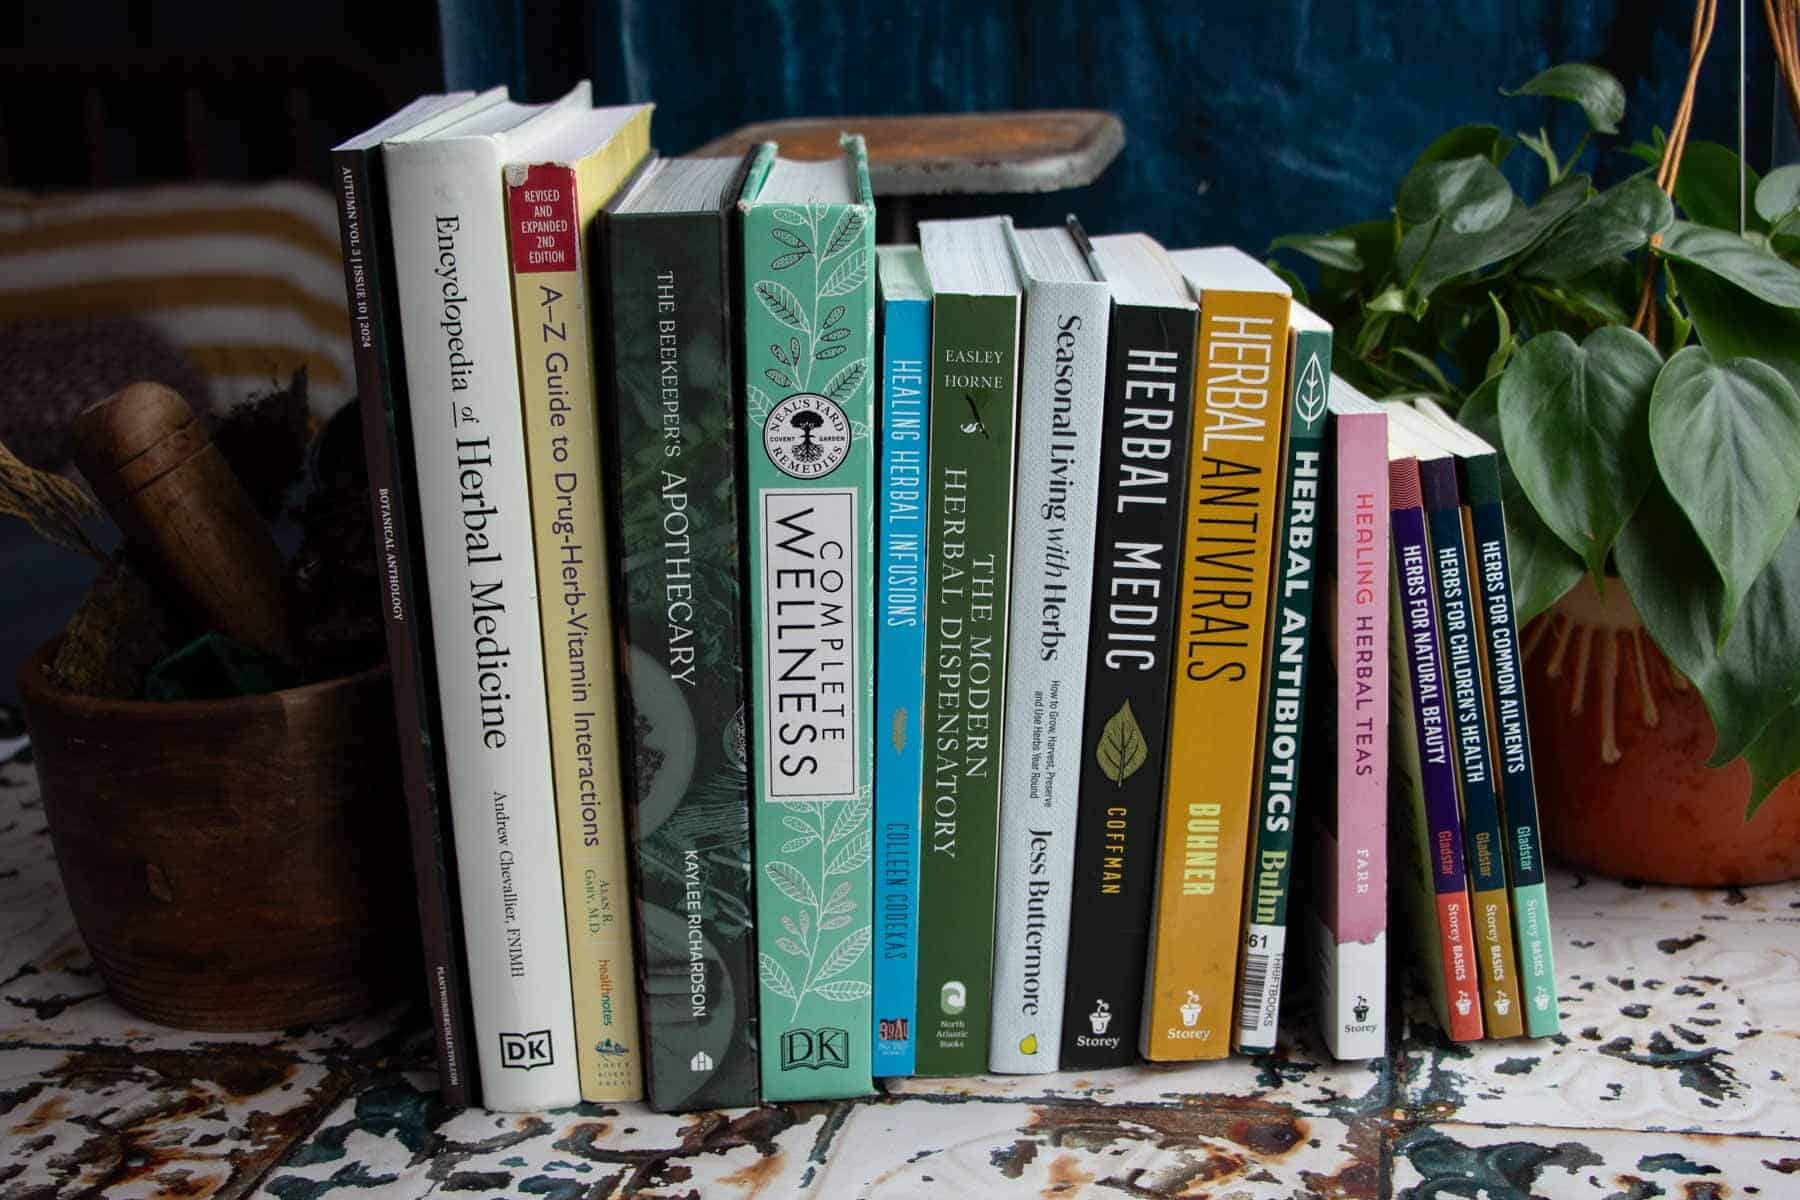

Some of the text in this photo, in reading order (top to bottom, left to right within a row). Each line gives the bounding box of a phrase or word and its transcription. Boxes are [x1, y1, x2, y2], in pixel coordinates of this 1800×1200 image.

[343, 167, 358, 220] AUTUMN
[521, 219, 568, 234] EXPANDED
[524, 189, 560, 202] REVISED
[534, 205, 553, 217] AND
[349, 221, 359, 246] VOL
[529, 250, 565, 264] EDITION
[536, 236, 555, 249] 2ND
[353, 265, 366, 298] ISSUE
[358, 302, 368, 315] 10
[360, 321, 372, 348] 2024
[945, 350, 1004, 364] EASLEY
[545, 352, 572, 427] Guide
[770, 399, 844, 432] NEAL'S YARD
[944, 375, 1004, 389] HORNE
[435, 215, 511, 749] Encyclopedia of Herbal Medicine
[552, 433, 569, 462] to
[657, 270, 696, 686] THE BEEKEEPER'S APOTHECARY
[773, 446, 843, 474] REMEDIES
[887, 359, 922, 628] HEALING HERBAL INFUSIONS
[1041, 314, 1082, 662] Seasonal Living with Herbs
[1105, 350, 1178, 670] HERBAL MEDIC
[1187, 315, 1274, 682] HERBAL ANTIVIRALS
[1284, 451, 1320, 598] HERBAL
[379, 488, 402, 620] BOTANICAL ANTHOLOGY
[552, 473, 592, 703] Drug-Herb-Vitamin
[775, 507, 818, 777] WELLNESS
[820, 540, 845, 741] COMPLETE
[934, 467, 967, 859] HERBAL DISPENSATORY
[965, 554, 996, 779] THE MODERN
[1356, 493, 1375, 777] HEALING HERBAL TEAS
[1403, 544, 1447, 764] HERBS FOR NATURAL BEAUTY
[1440, 547, 1485, 784] HERBS FOR CHILDREN'S HEALTH
[1482, 540, 1525, 774] HERBS FOR COMMON AILMENTS
[1049, 701, 1060, 710] to
[1050, 680, 1061, 700] How
[1266, 607, 1307, 833] ANTIBIOTICS
[574, 712, 601, 848] Interactions
[493, 792, 509, 846] Andrew
[1101, 807, 1128, 895] COFFMAN
[1183, 803, 1222, 896] BUHNER
[1437, 830, 1453, 876] Gladstar
[1476, 832, 1491, 877] Gladstar
[1516, 826, 1532, 872] Gladstar
[500, 850, 522, 924] Chevallier,
[884, 823, 910, 960] COLLEEN CODEKAS
[1356, 849, 1369, 895] FARR
[684, 850, 707, 1017] KAYLEE RICHARDSON
[1021, 828, 1053, 1016] Jess Buttermore
[1447, 903, 1466, 982] Storey BASICS
[1485, 903, 1504, 982] Storey BASICS
[1525, 899, 1545, 977] Storey BASICS
[507, 1039, 547, 1061] DK
[787, 1031, 843, 1064] DK
[1076, 1035, 1120, 1049] Storey
[1167, 1028, 1210, 1041] Storey
[1344, 1022, 1378, 1034] Storey
